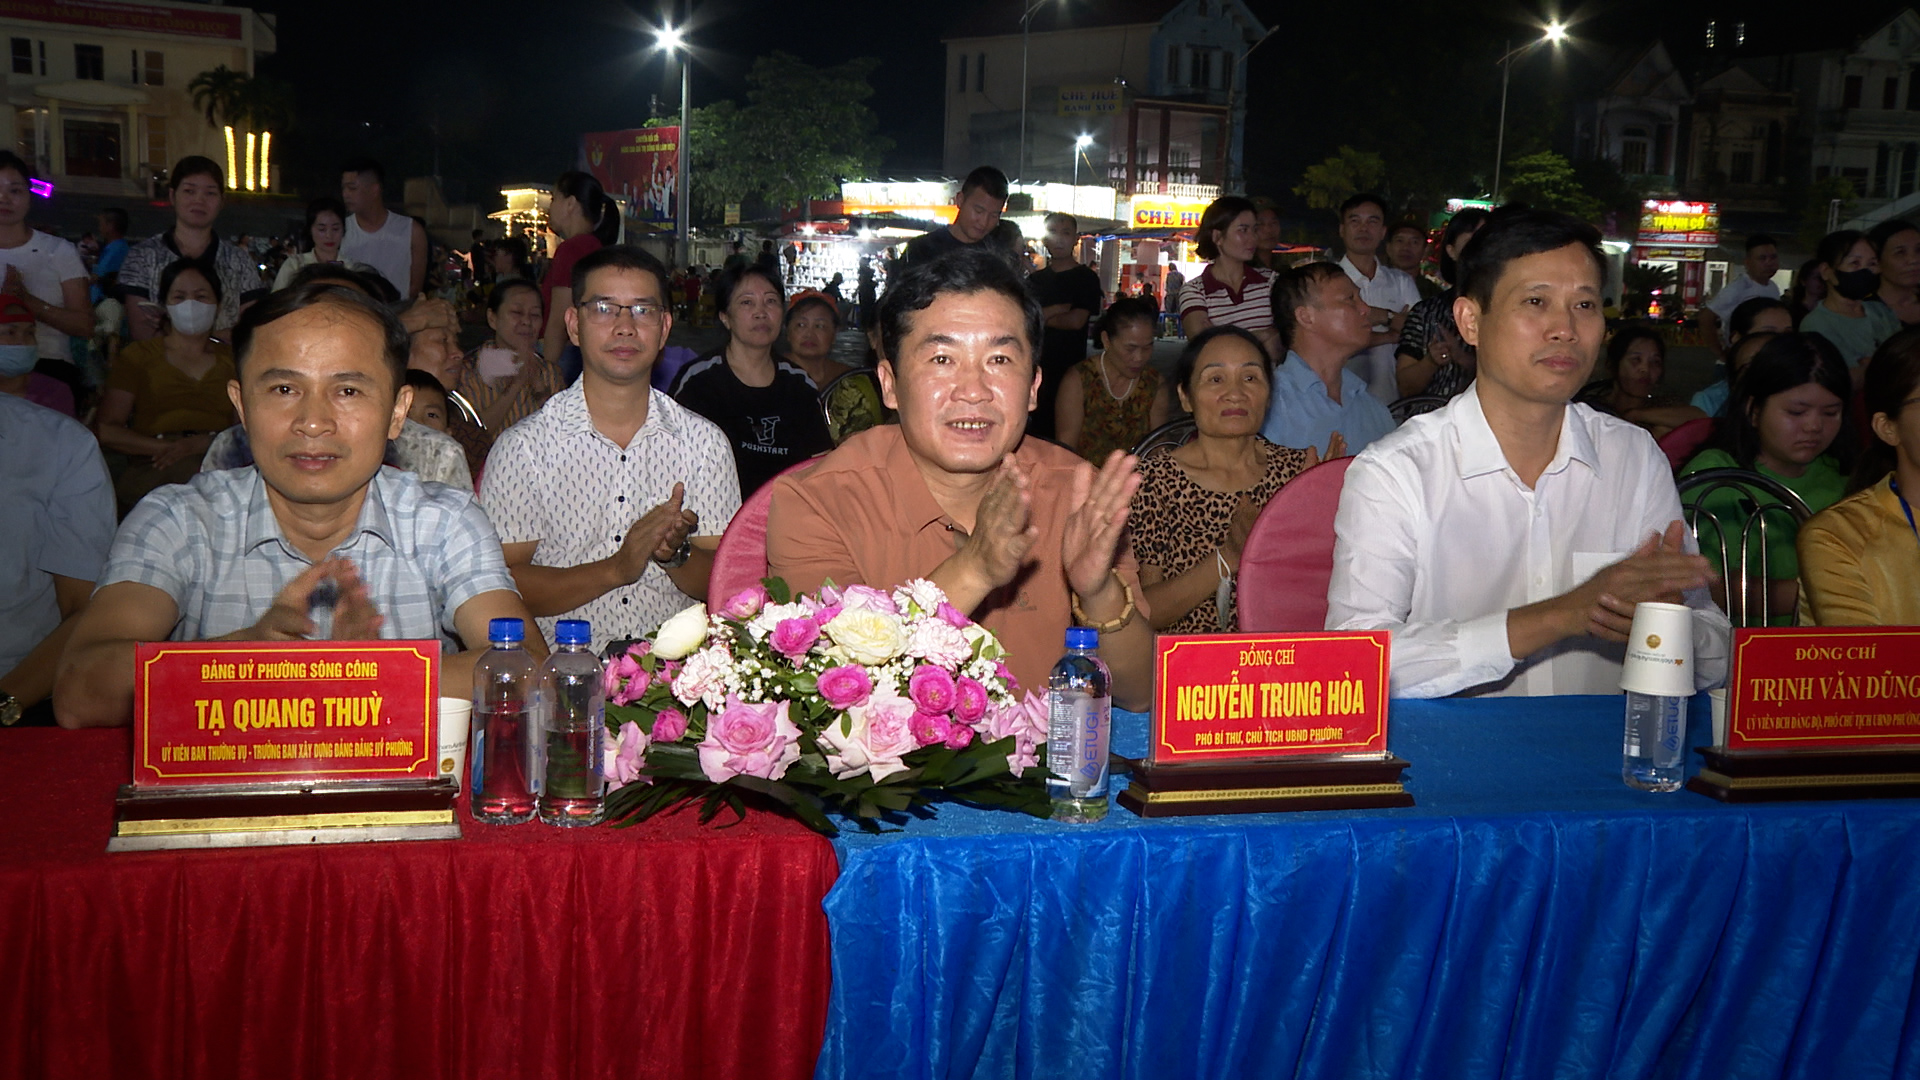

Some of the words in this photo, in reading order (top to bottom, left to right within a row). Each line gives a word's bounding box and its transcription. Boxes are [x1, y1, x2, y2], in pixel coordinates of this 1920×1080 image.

[1136, 206, 1174, 225] CHÈ
[1180, 212, 1202, 226] HU
[1239, 642, 1273, 667] ĐỒNG
[1274, 644, 1295, 665] CHÍ
[1846, 643, 1877, 660] CHÍ
[201, 659, 236, 680] ĐẢNG
[257, 659, 307, 679] PHƯỜNG
[309, 659, 342, 679] SÔNG
[345, 659, 378, 678] CÔNG
[1176, 670, 1255, 721] NGUYỄN
[1260, 681, 1322, 718] TRUNG
[1327, 671, 1365, 716] HÒA
[1750, 677, 1815, 707] TRỊNH
[1819, 670, 1861, 700] VĂN
[1865, 670, 1920, 699] DŨNG
[195, 699, 226, 736] TẠ
[233, 698, 316, 733] QUANG
[1667, 697, 1680, 735] ETUG
[1084, 711, 1099, 761] ETUGI
[1195, 731, 1212, 746] PHÓ
[1214, 730, 1224, 745] BÍ
[1245, 726, 1263, 744] CHỦ
[1264, 730, 1284, 745] TỊCH
[1285, 729, 1308, 742] UBND
[1309, 725, 1343, 742] PHƯỜNG
[173, 743, 190, 762] VIÊN
[191, 746, 206, 761] BAN
[208, 741, 236, 761] THƯỜNG
[237, 745, 248, 763] VỤ
[282, 744, 297, 759] BAN
[298, 740, 312, 759] XÂY
[334, 737, 353, 758] ĐẢNG
[354, 737, 374, 757] ĐẢNG
[385, 738, 413, 757] PHƯỜNG
